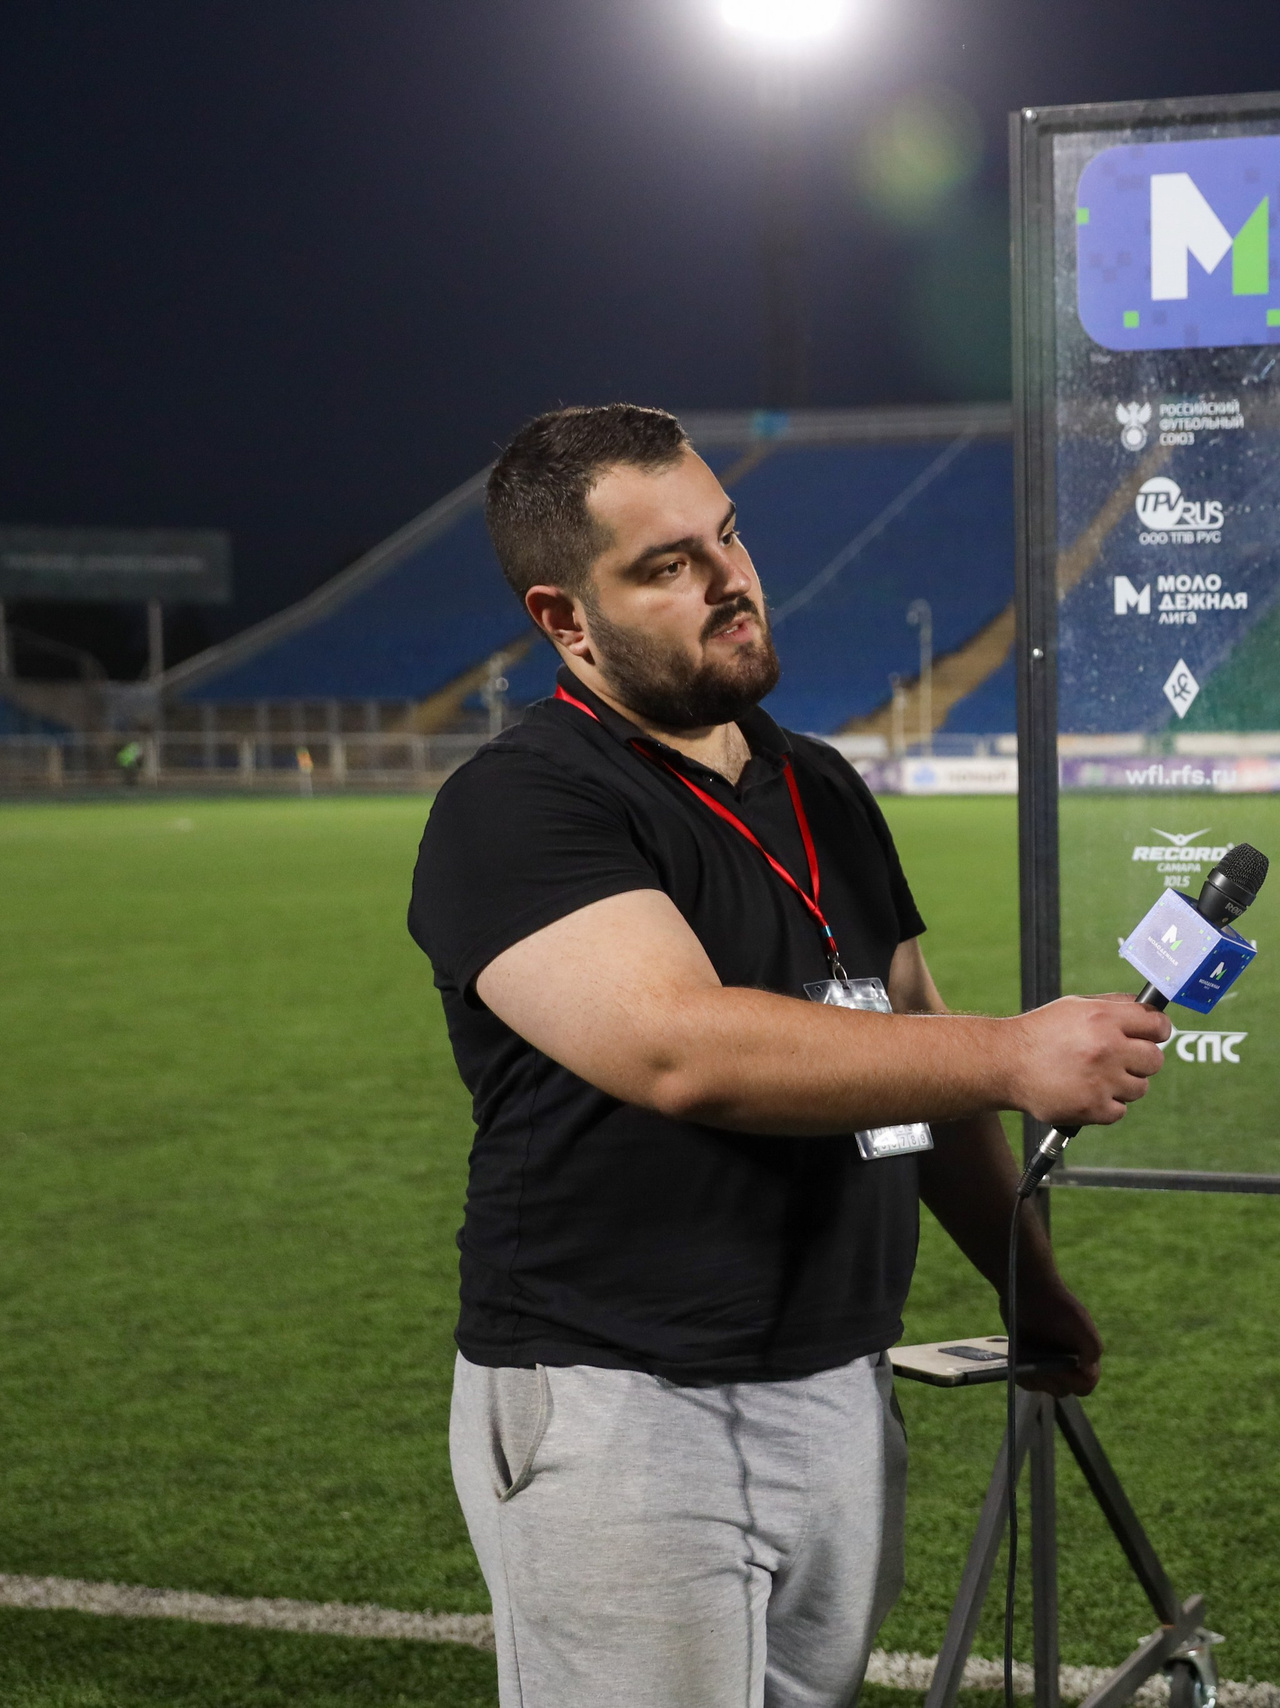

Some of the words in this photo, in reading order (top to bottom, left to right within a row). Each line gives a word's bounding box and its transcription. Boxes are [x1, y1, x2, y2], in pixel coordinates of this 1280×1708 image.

[1159, 399, 1240, 416] РОССИЙСКИЙ
[1159, 414, 1245, 430] ФУТБОЛЬНЫЙ
[1159, 432, 1195, 446] СОЮЗ
[1170, 531, 1195, 545] ТПВ
[1196, 530, 1222, 544] РУС
[1157, 573, 1222, 592] МОЛО
[1157, 591, 1248, 611] ДЕЖНАЯ
[1157, 609, 1197, 625] лига
[1125, 764, 1237, 785] wfl.rfs.ru
[1157, 862, 1201, 873] САМАРА
